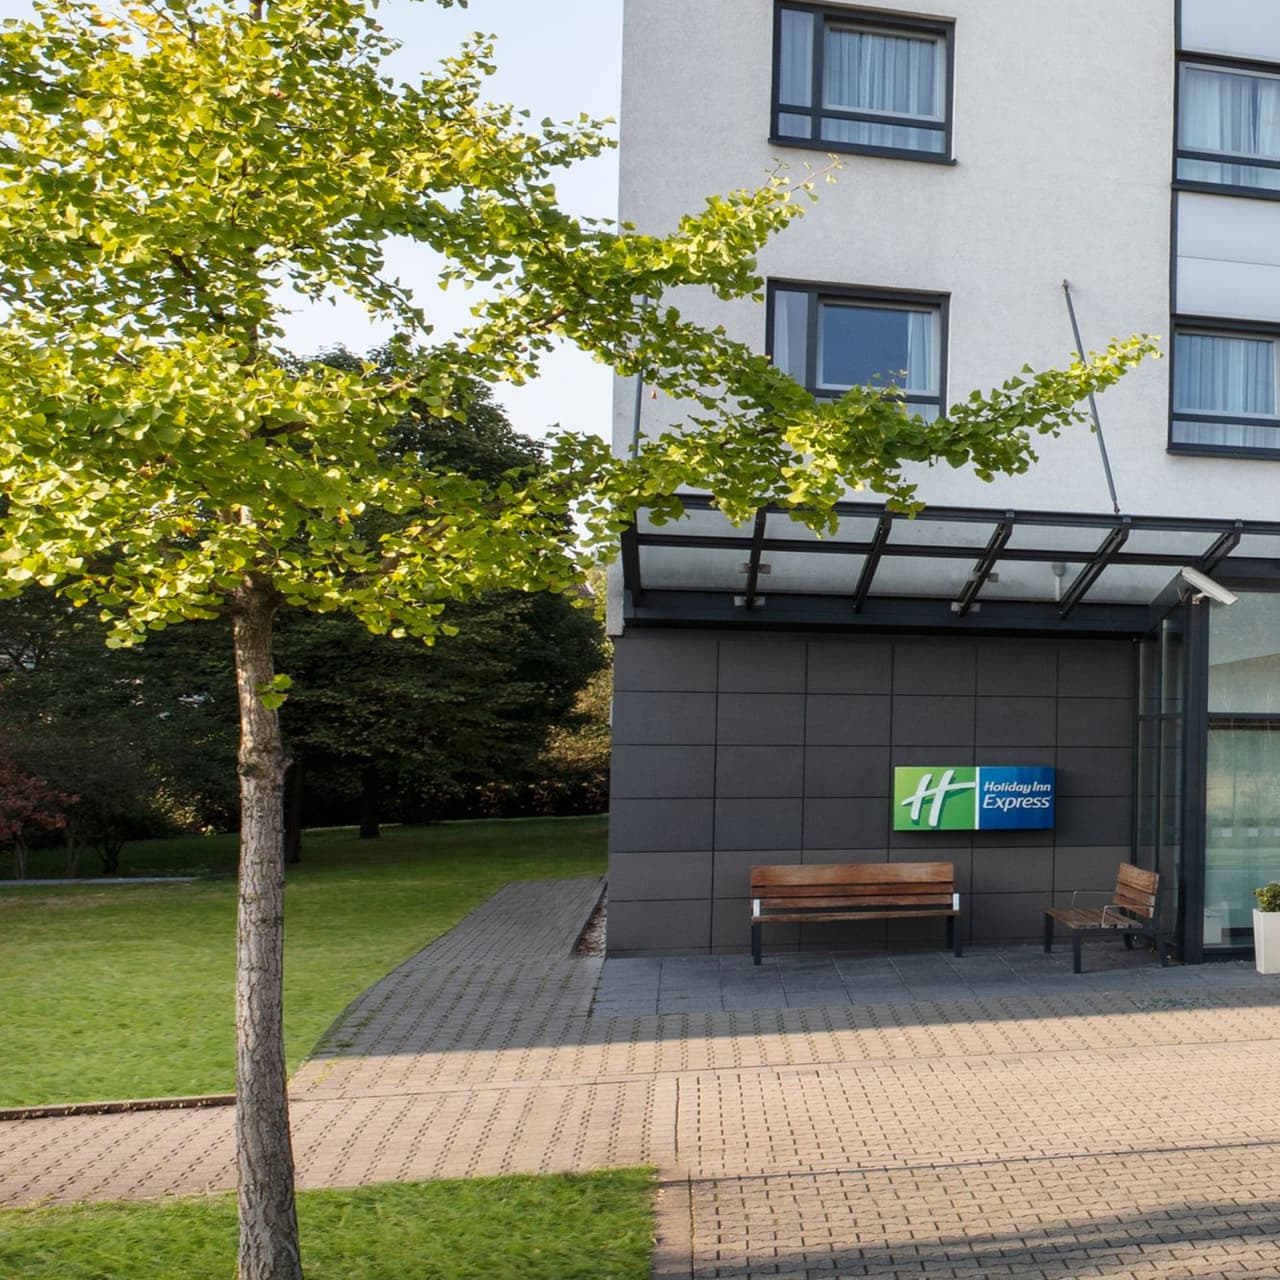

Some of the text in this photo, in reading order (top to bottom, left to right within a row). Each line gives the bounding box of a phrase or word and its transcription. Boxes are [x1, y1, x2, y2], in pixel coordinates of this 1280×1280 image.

[984, 781, 1051, 794] Holiday Inn
[983, 794, 1052, 812] Express
